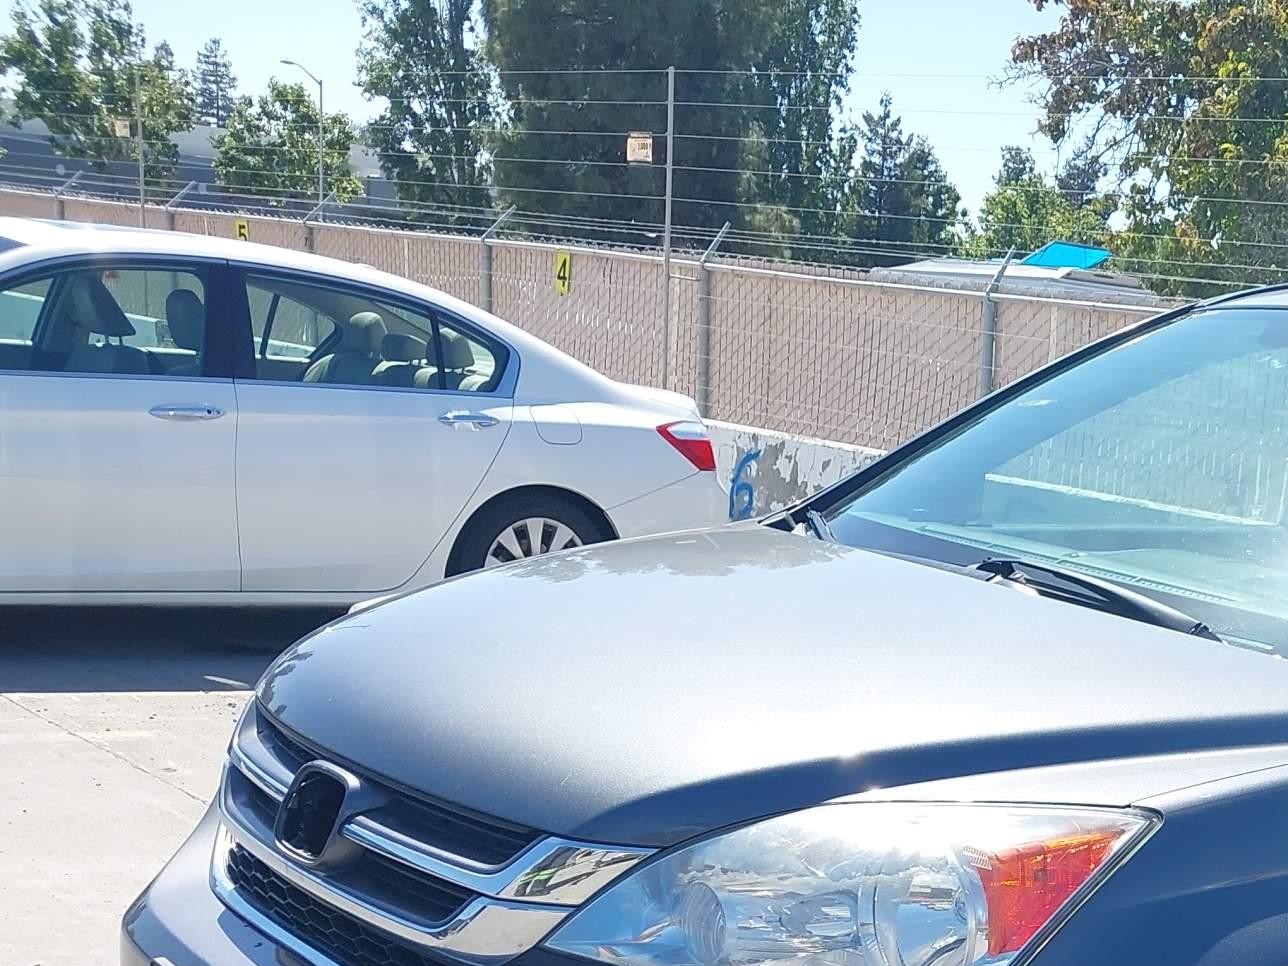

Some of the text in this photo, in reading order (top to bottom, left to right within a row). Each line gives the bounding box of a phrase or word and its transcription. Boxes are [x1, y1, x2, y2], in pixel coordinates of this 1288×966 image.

[238, 224, 248, 241] 5
[557, 258, 567, 287] 4
[729, 449, 762, 520] 6
